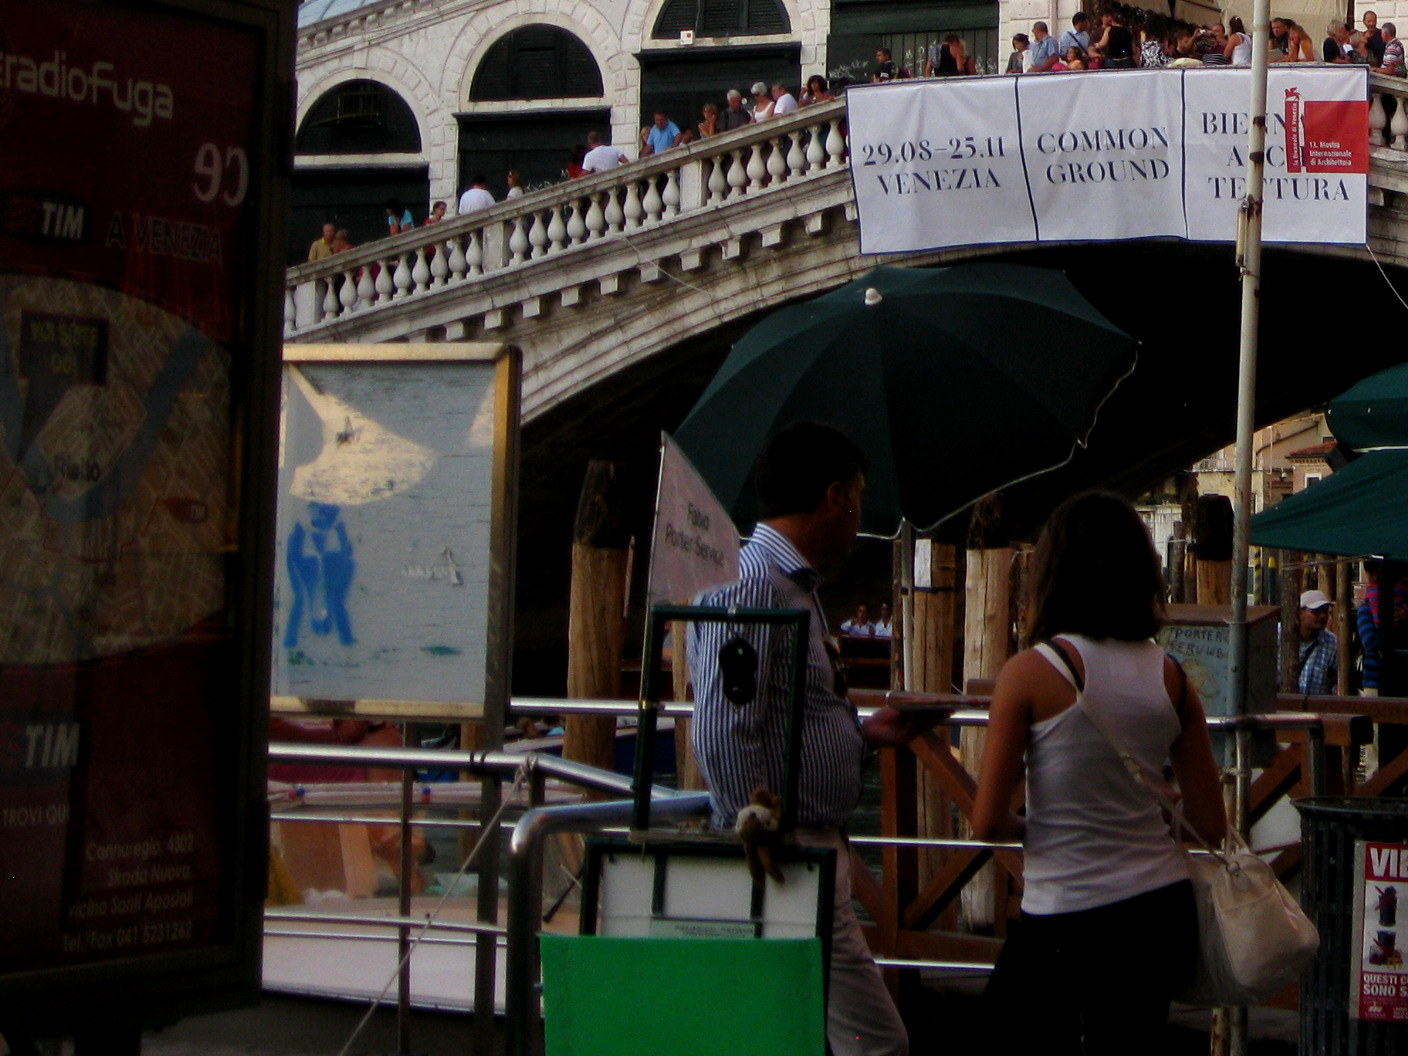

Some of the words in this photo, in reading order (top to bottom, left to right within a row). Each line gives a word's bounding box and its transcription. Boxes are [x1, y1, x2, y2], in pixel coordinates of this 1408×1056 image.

[1037, 127, 1168, 154] COMMON
[1319, 140, 1340, 149] Mostra
[1309, 148, 1352, 158] Internazionale
[1309, 157, 1317, 166] di
[1317, 157, 1352, 167] Architettura
[877, 168, 1002, 195] VENEZIA
[1046, 158, 1170, 185] GROUND
[1208, 177, 1349, 201] TETURA
[41, 200, 85, 241] TIM
[105, 210, 127, 250] A
[132, 213, 222, 264] VENEZIA
[1174, 628, 1222, 642] PORTER
[26, 722, 81, 768] TIM
[68, 896, 107, 918] vicino
[144, 888, 194, 912] Apostoli
[117, 924, 138, 947] 041
[1363, 973, 1397, 984] QUESTI
[1363, 984, 1396, 996] SONO
